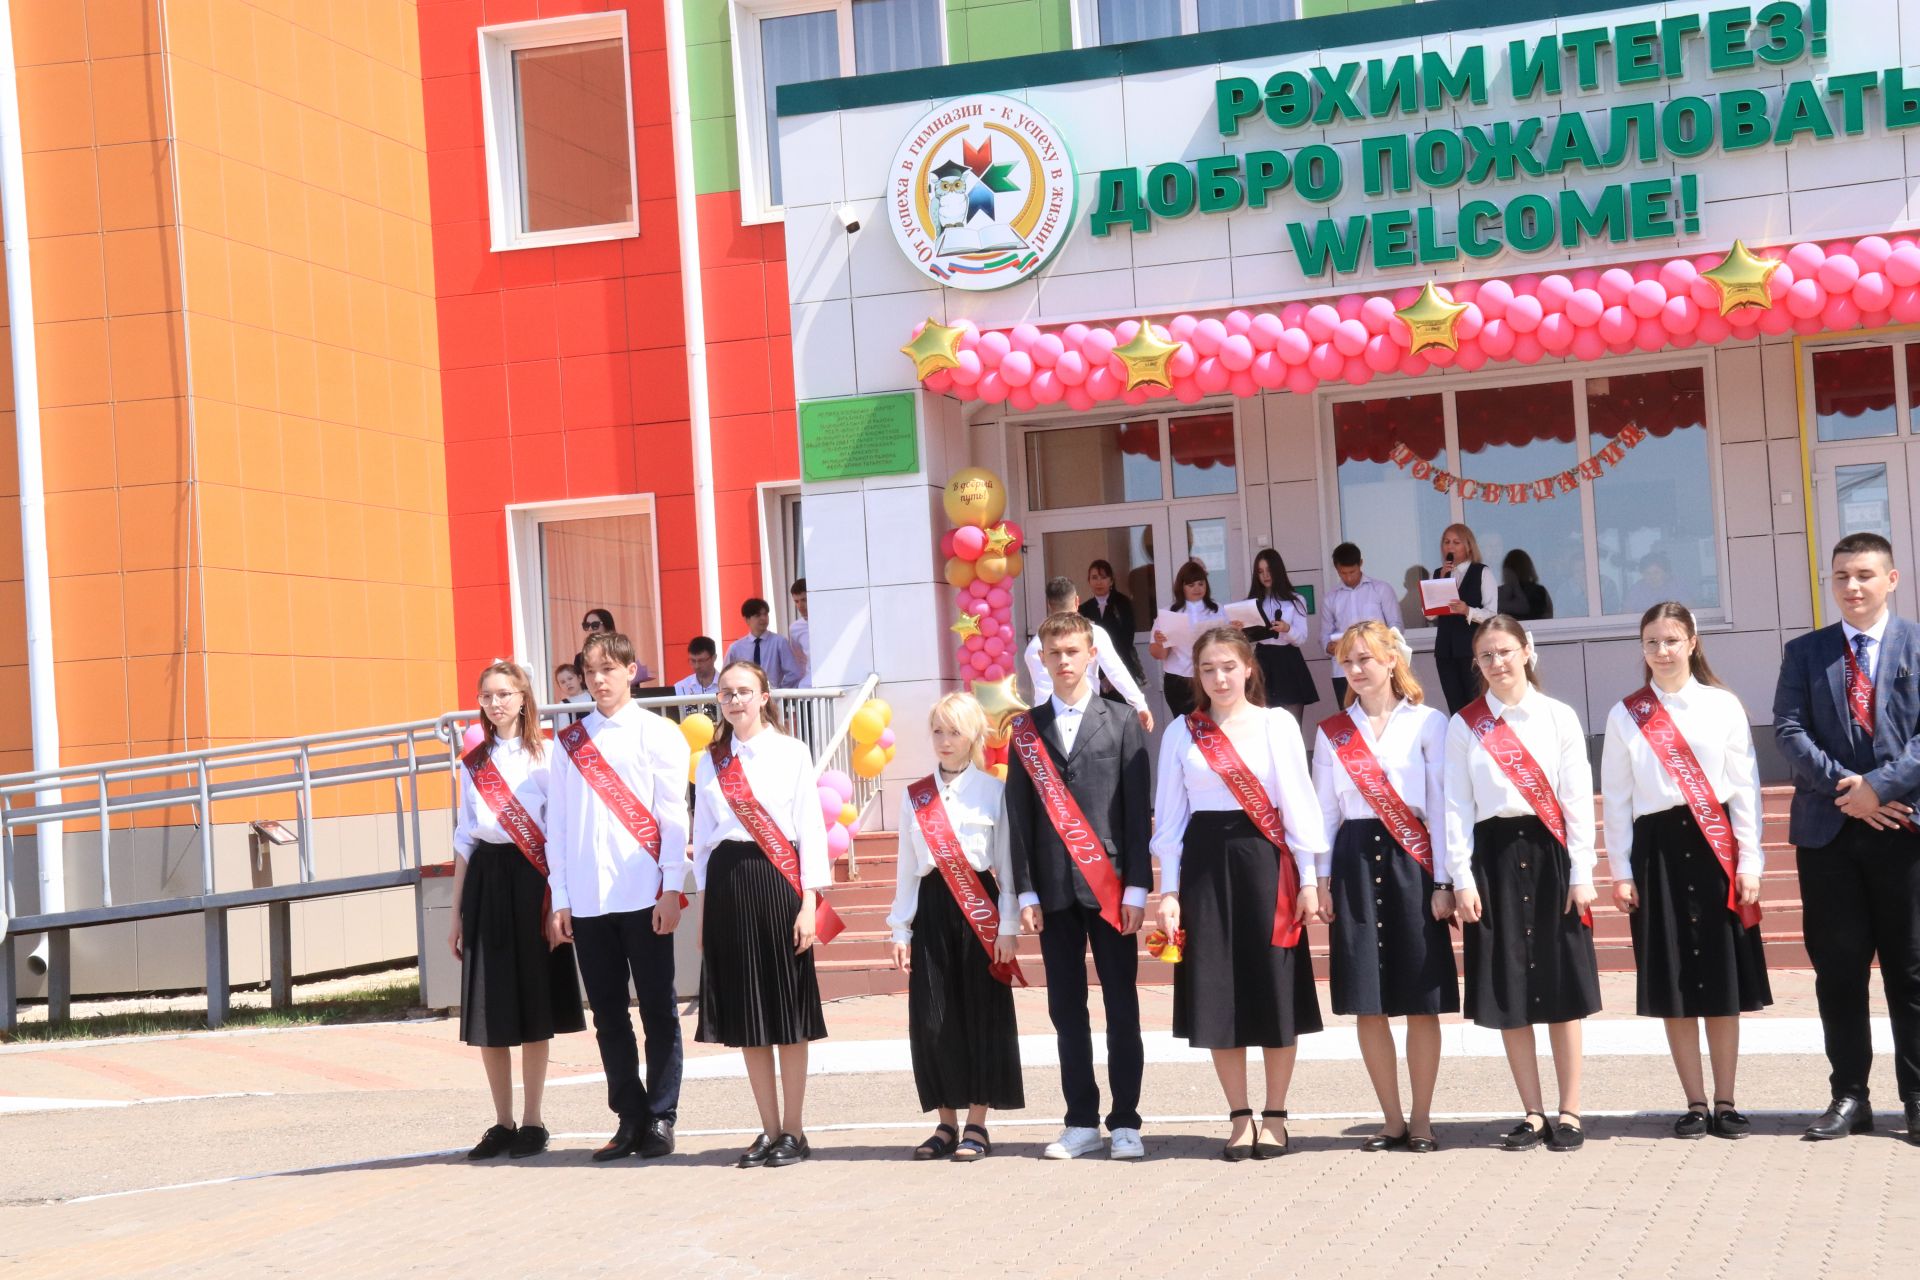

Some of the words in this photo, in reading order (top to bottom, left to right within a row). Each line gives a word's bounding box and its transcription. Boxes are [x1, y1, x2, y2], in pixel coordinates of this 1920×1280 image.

[1509, 0, 1828, 98] ИТЕГЕЗ!
[908, 103, 983, 156] гимназии
[1013, 113, 1060, 162] успеху
[1090, 144, 1343, 237] ДОБРО
[1361, 67, 1920, 195] ПОЖАЛОВАТЬ
[897, 177, 921, 238] успеха
[1031, 186, 1065, 253] жизни!
[1286, 174, 1700, 277] WELCOME!
[913, 240, 933, 263] От
[574, 744, 640, 820] Выпускник
[1015, 732, 1071, 820] Выпускник
[1059, 818, 1102, 865] 2023
[1196, 729, 1263, 811] Выпускница
[1342, 749, 1412, 839] Выпускница
[1643, 718, 1712, 817] Выпускница
[920, 809, 976, 902] Выпускница
